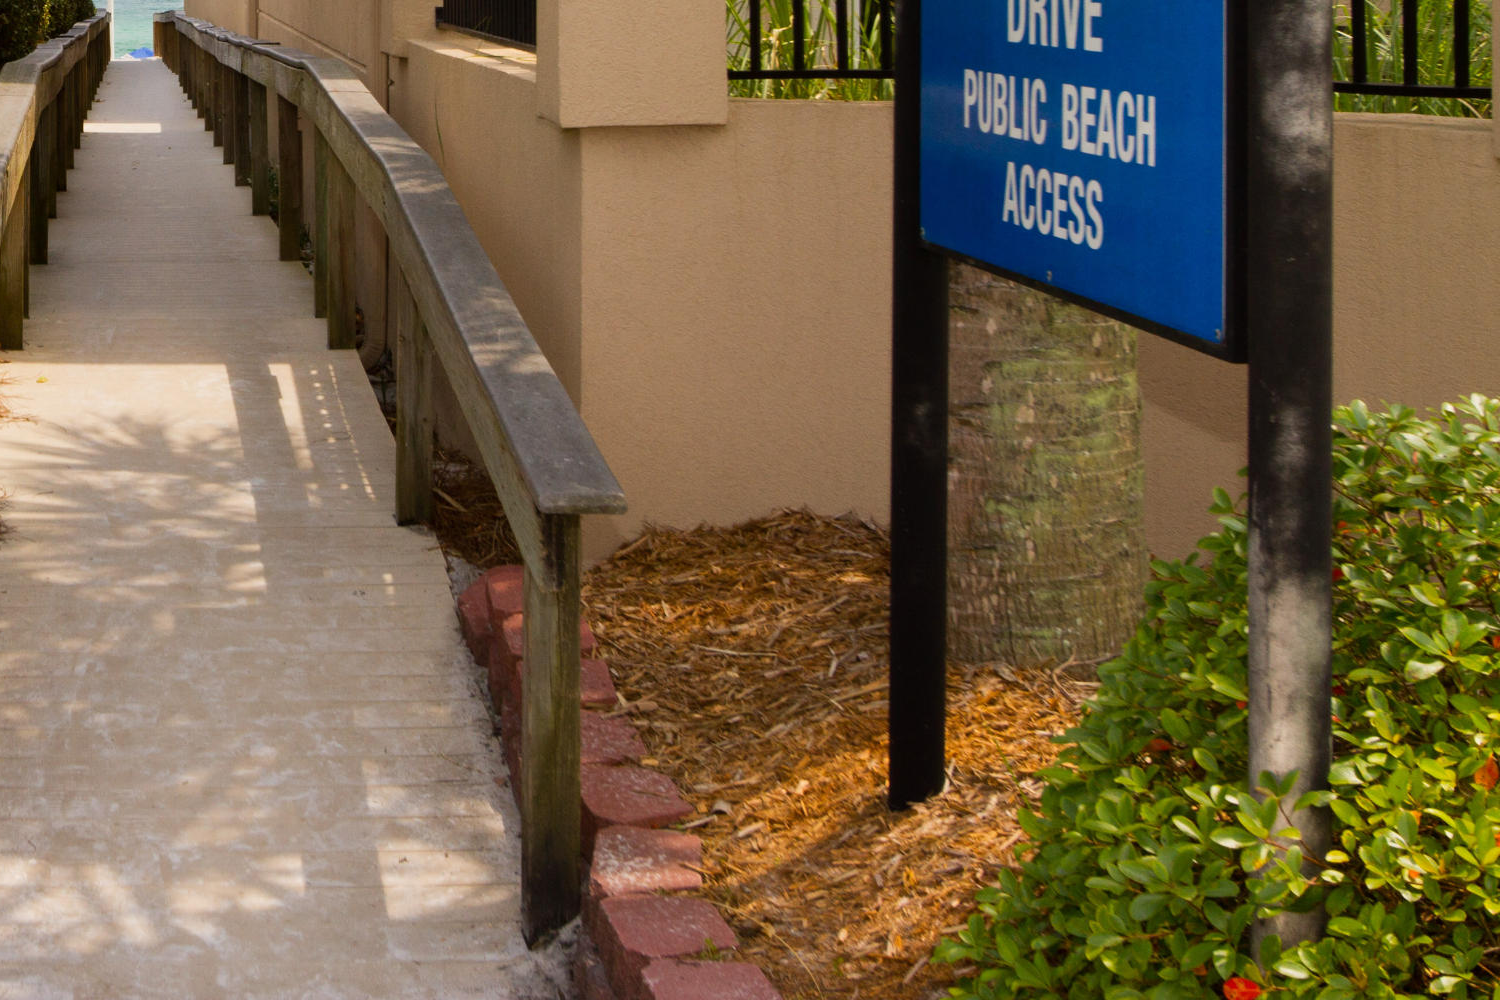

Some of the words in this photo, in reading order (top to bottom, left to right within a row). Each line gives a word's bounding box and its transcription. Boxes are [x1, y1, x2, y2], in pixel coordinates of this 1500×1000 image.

[963, 68, 1047, 145] PUBLIC
[1061, 83, 1156, 168] BEACH
[1002, 161, 1104, 250] ACCESS
